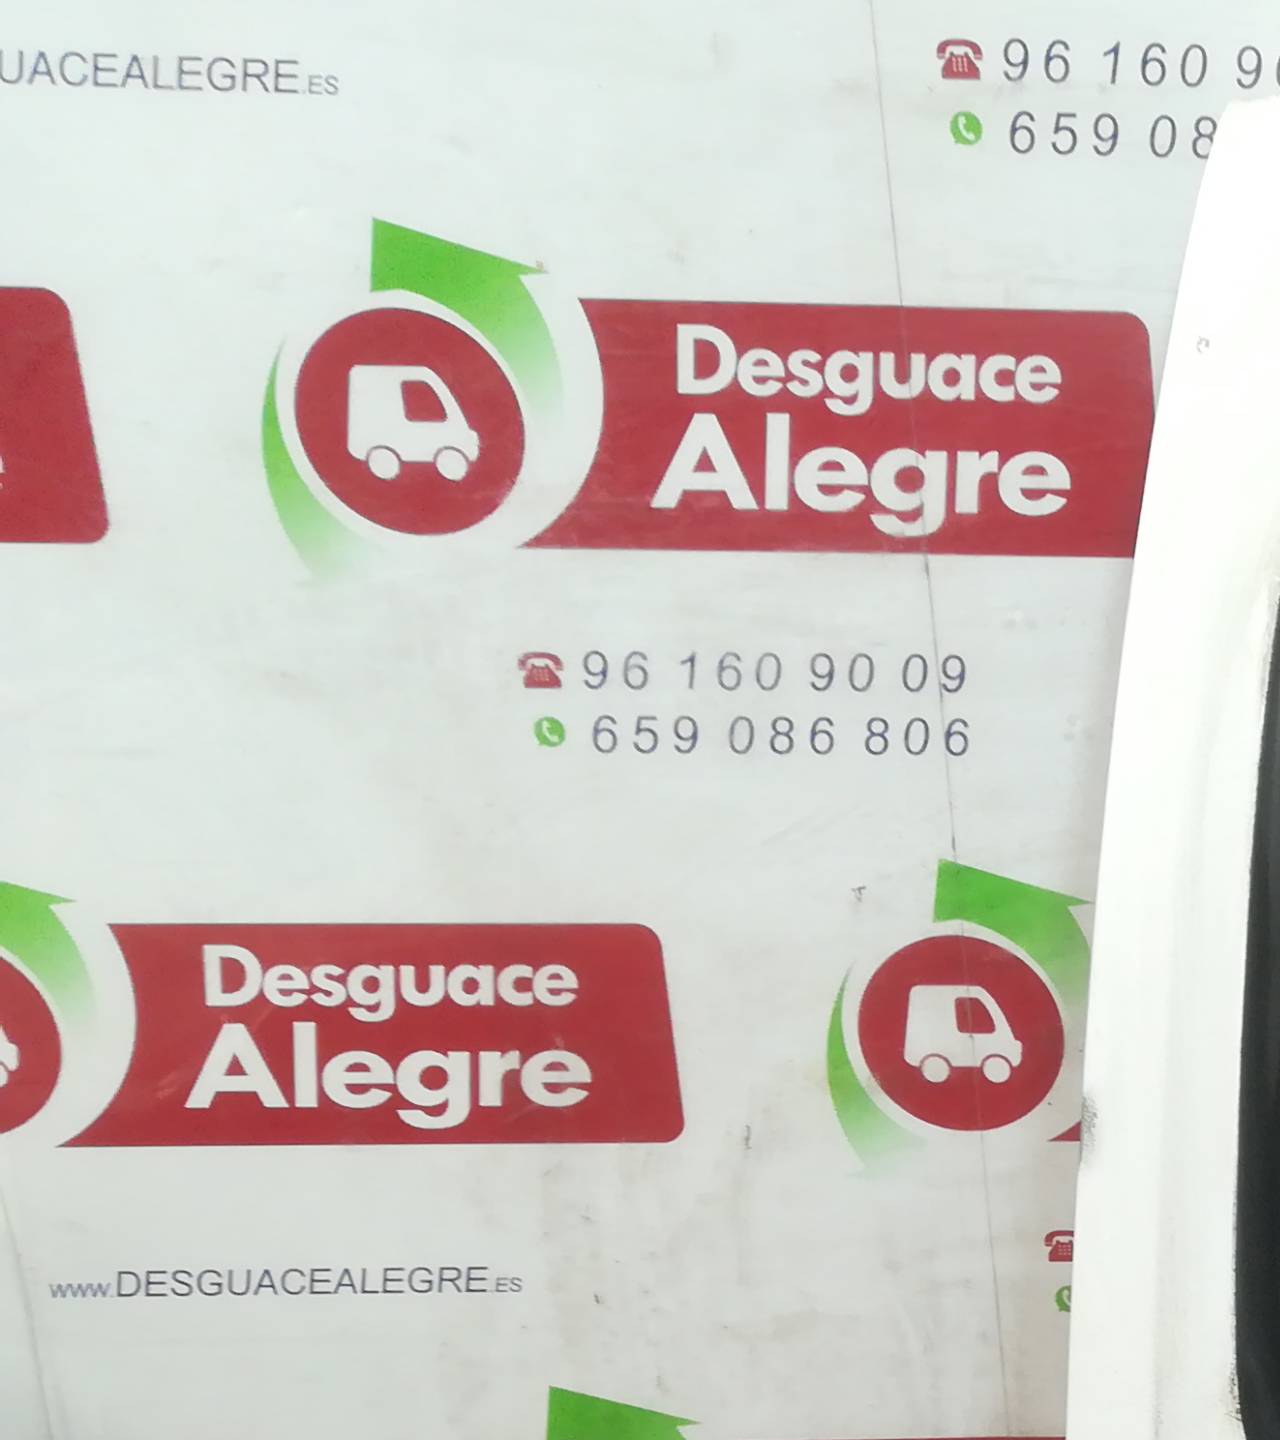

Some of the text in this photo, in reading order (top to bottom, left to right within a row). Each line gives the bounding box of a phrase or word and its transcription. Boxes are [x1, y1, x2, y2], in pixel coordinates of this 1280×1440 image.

[0, 50, 340, 97] UACEALEGRE.ES
[1000, 37, 1071, 83] 96
[1101, 41, 1209, 88] 160
[1009, 111, 1216, 160] 659 08
[676, 324, 1062, 415] Desguace
[651, 413, 1071, 536] Alegre
[582, 651, 968, 695] 96 160 90 09
[592, 715, 971, 758] 659 086 806
[201, 943, 579, 1022] Desguace
[184, 1021, 592, 1130] Alegre
[49, 1266, 523, 1301] www.DESGUACEALEGRE.ES
